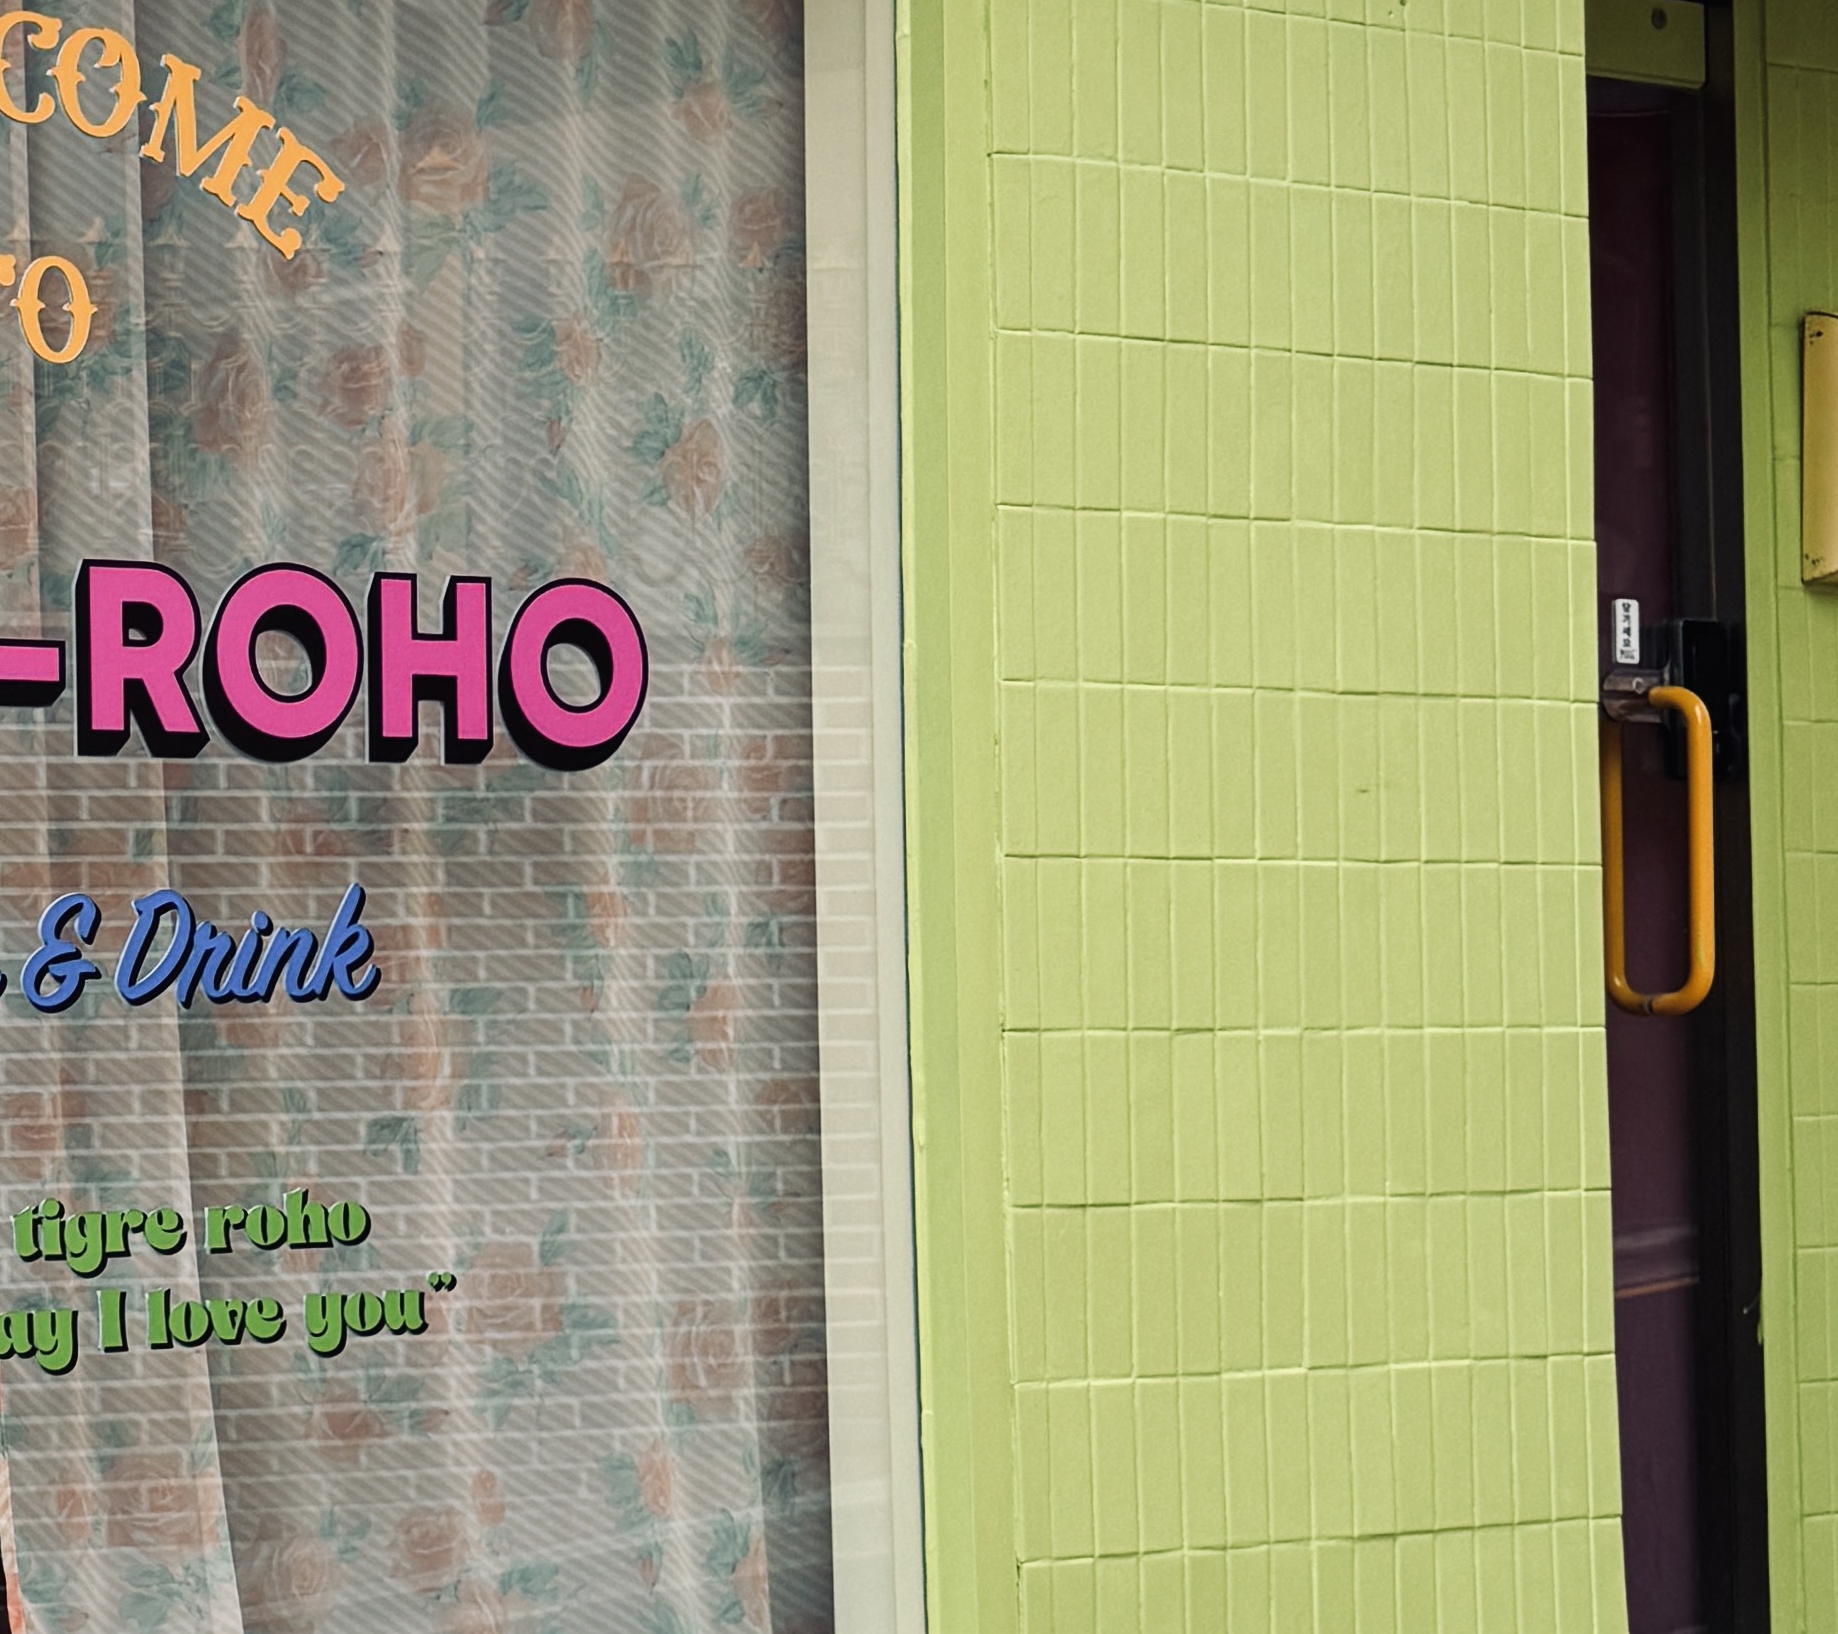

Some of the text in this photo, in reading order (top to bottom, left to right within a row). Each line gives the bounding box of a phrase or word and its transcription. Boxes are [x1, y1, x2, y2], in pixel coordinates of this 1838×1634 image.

[19, 892, 103, 1014] &
[113, 883, 382, 1010] Drink
[12, 1197, 188, 1278] tigre
[204, 1187, 371, 1254] roho
[97, 1287, 130, 1353] I
[144, 1287, 288, 1350] love
